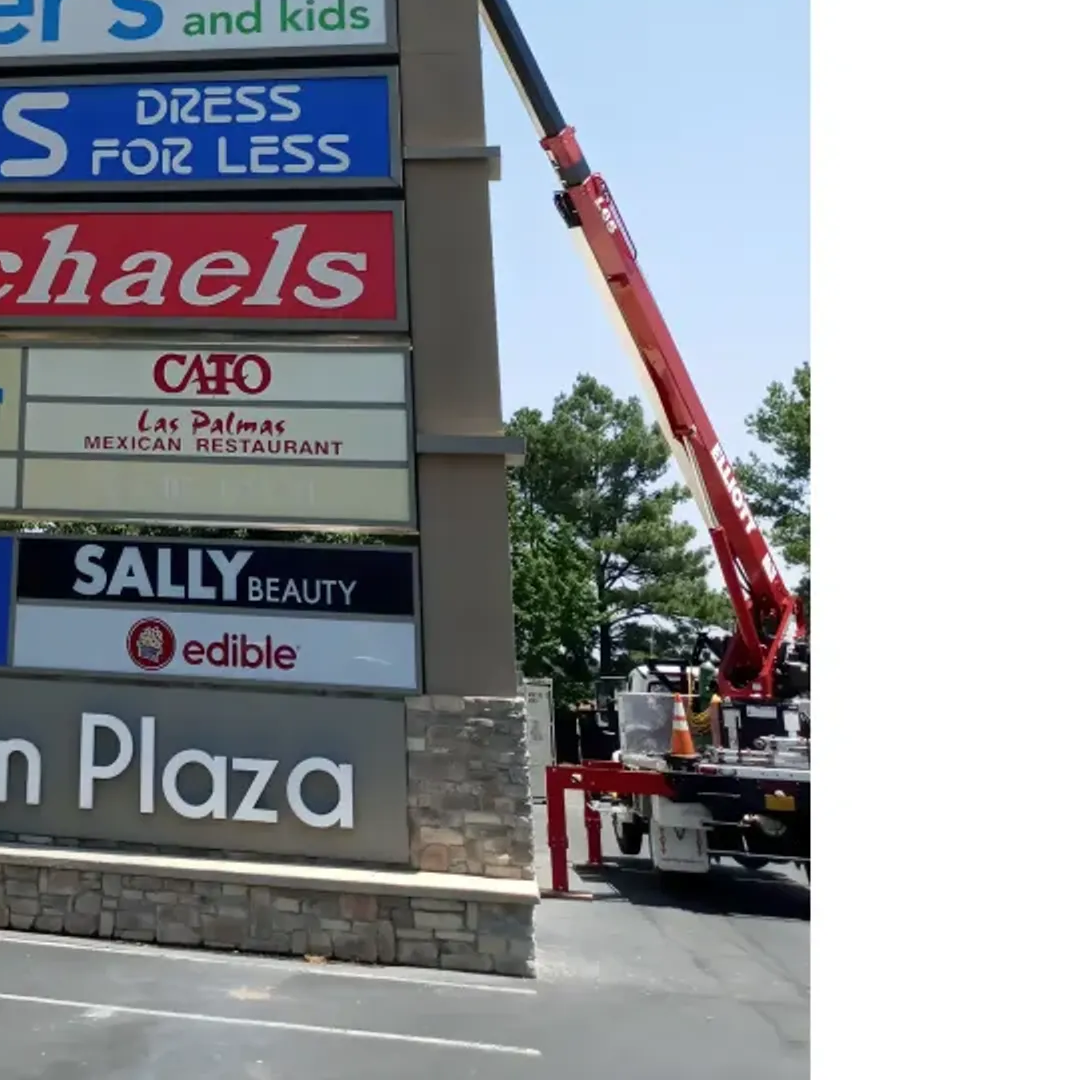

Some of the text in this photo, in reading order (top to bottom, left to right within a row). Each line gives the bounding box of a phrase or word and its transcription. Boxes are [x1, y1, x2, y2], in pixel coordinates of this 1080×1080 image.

[183, 2, 263, 36] and
[137, 86, 302, 125] DRESS
[92, 134, 350, 176] FOR LESS
[152, 353, 271, 395] CATO
[137, 409, 286, 437] Las Palmas
[84, 435, 343, 456] MEXICAN RESTAURANT
[73, 544, 356, 606] SALLY BEAUTY
[182, 633, 298, 669] edible
[78, 712, 354, 828] Plaza
